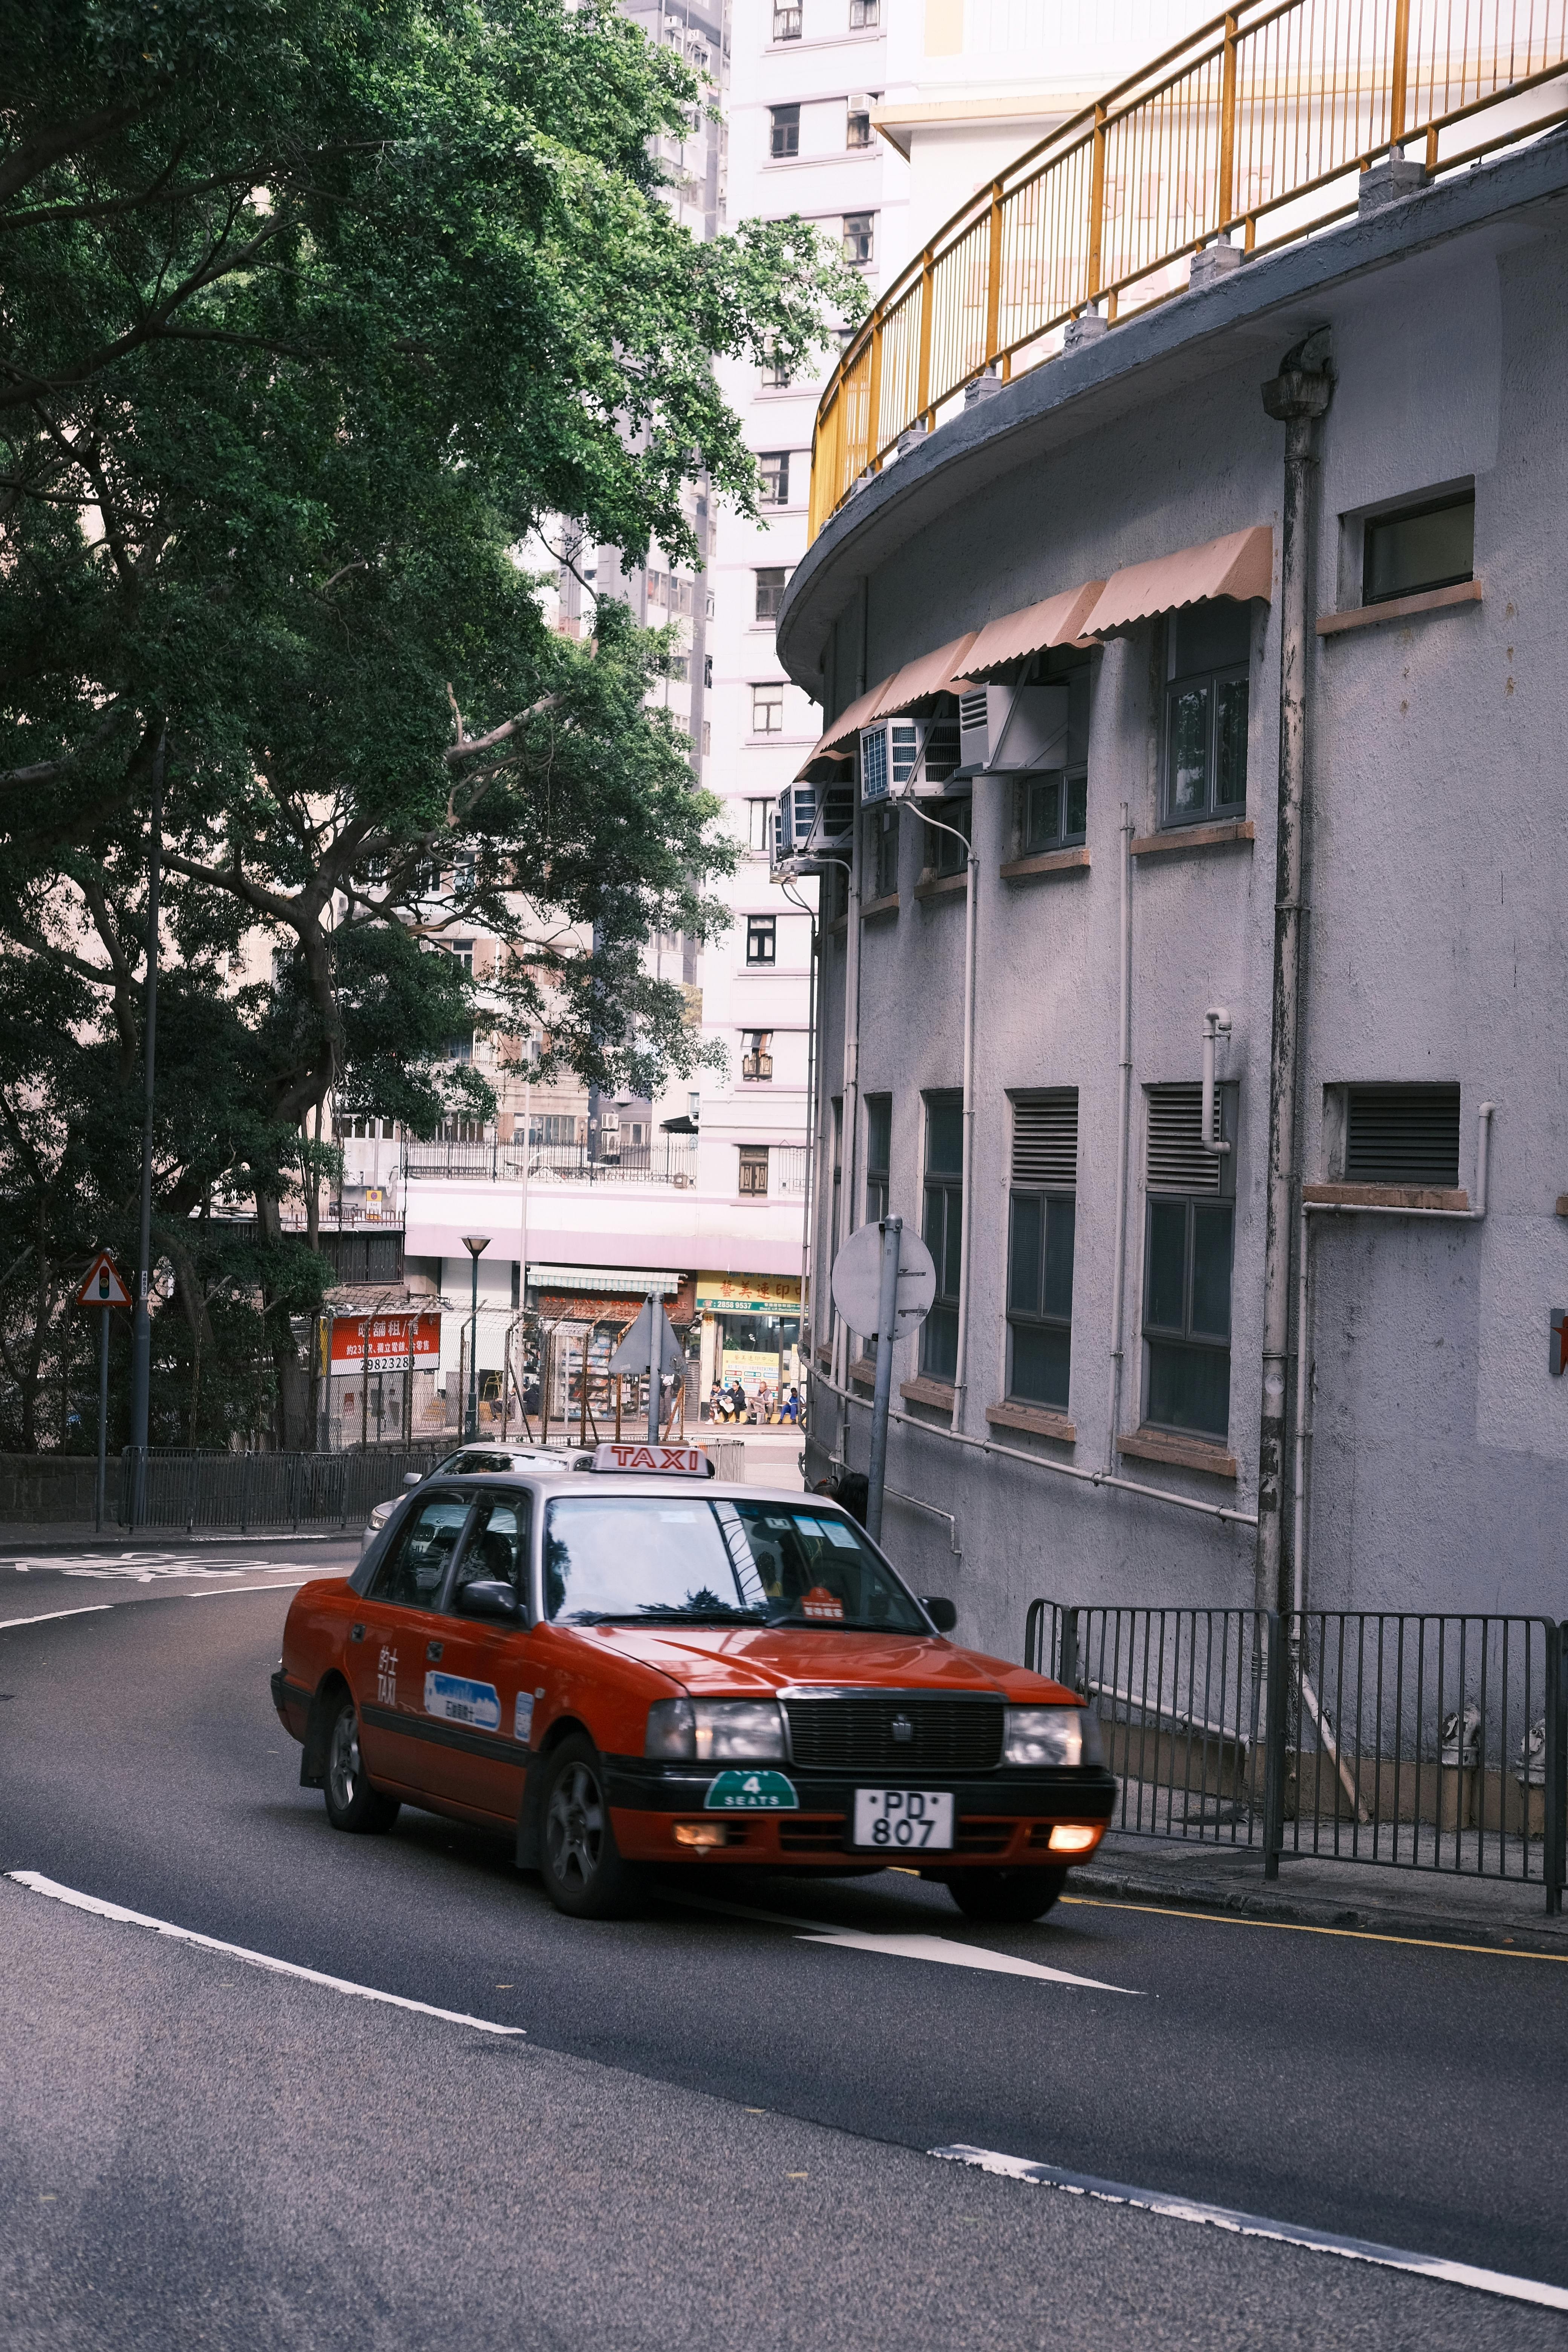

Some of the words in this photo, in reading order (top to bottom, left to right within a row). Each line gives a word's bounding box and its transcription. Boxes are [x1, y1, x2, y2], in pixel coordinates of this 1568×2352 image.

[611, 1446, 697, 1470] TAXI
[82, 1552, 343, 1573] SLOW
[378, 1645, 399, 1676] 的士
[377, 1673, 396, 1706] TAXI
[742, 1776, 762, 1795] 4
[724, 1796, 779, 1805] SEATS
[884, 1791, 925, 1820] PD
[872, 1818, 936, 1847] 807
